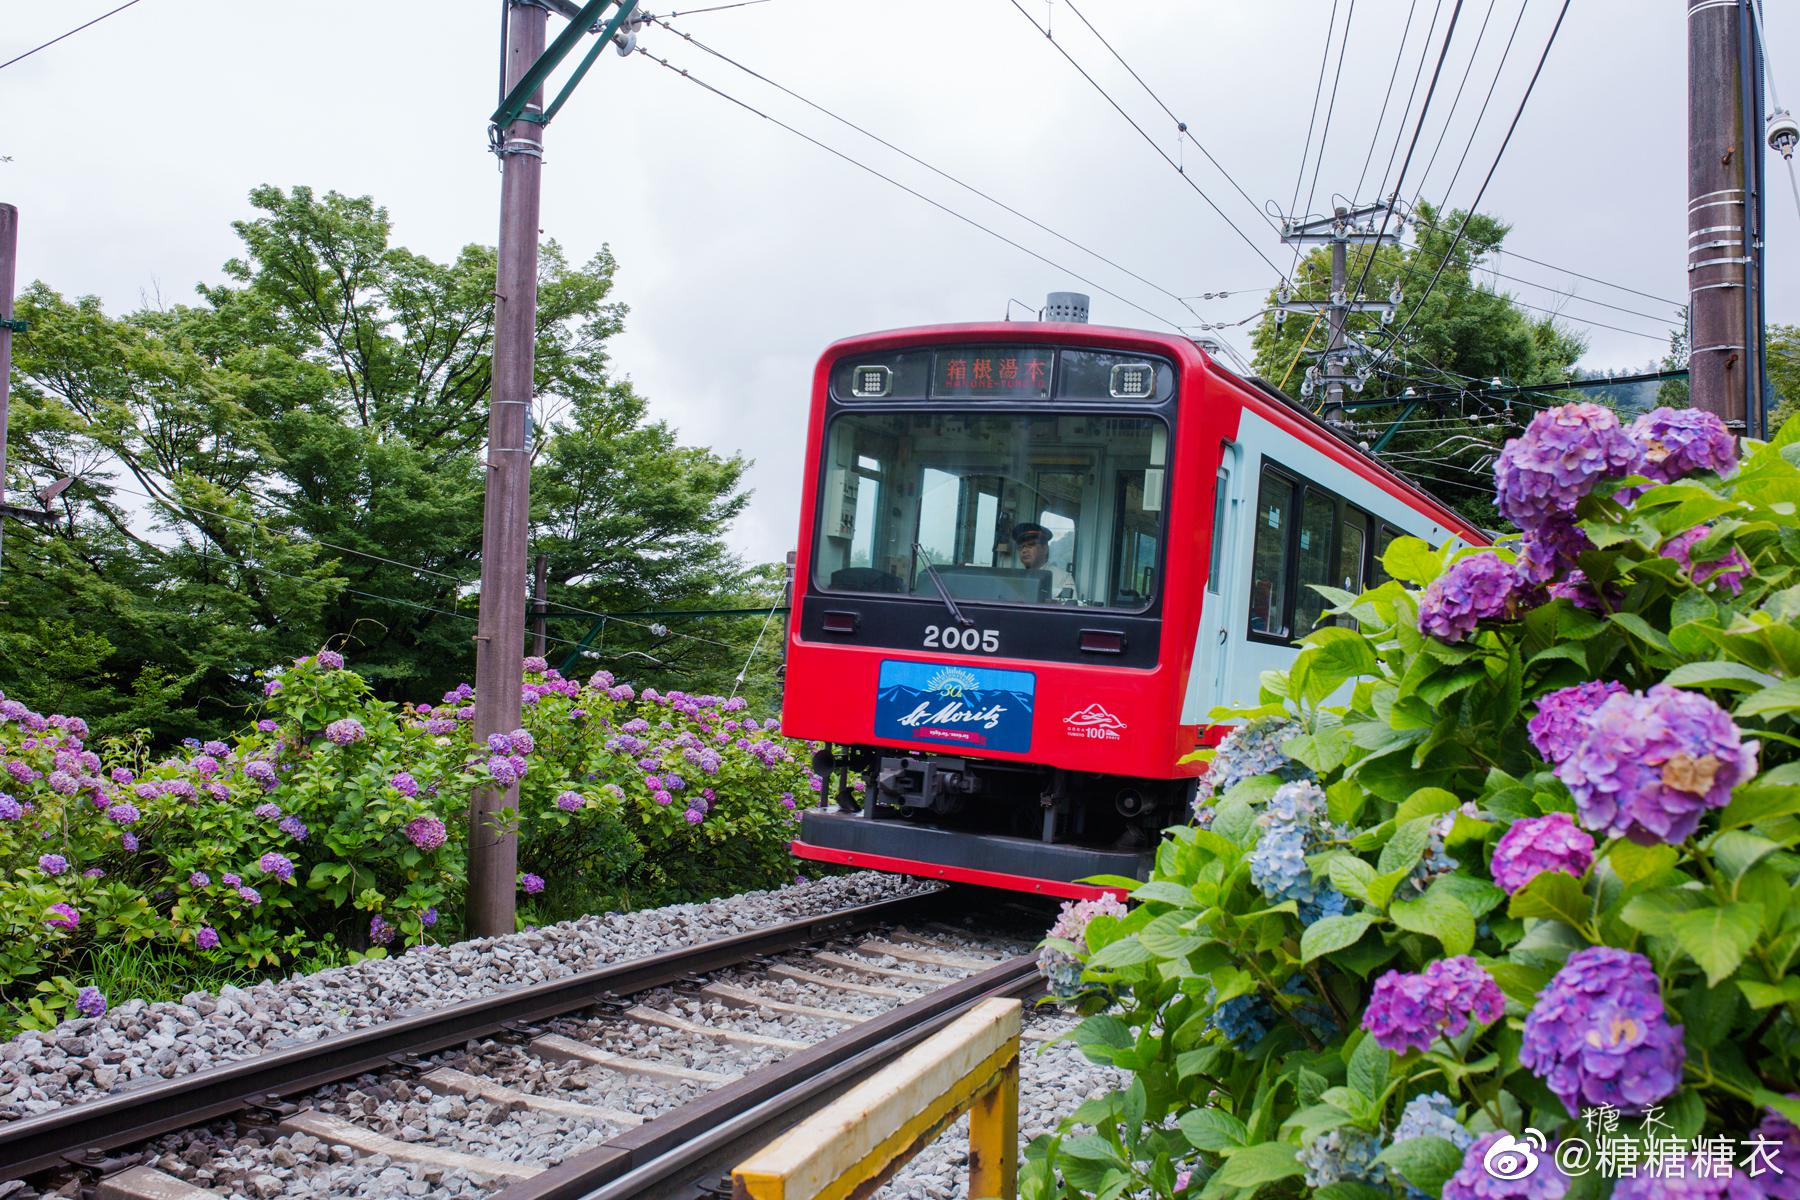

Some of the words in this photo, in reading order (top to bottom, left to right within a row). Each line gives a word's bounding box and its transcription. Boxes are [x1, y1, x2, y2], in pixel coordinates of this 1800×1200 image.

[947, 358, 1046, 384] 箱根湯本
[923, 625, 999, 653] 2005
[897, 701, 932, 727] St.
[922, 701, 1008, 729] Moritz
[1085, 727, 1105, 739] 100
